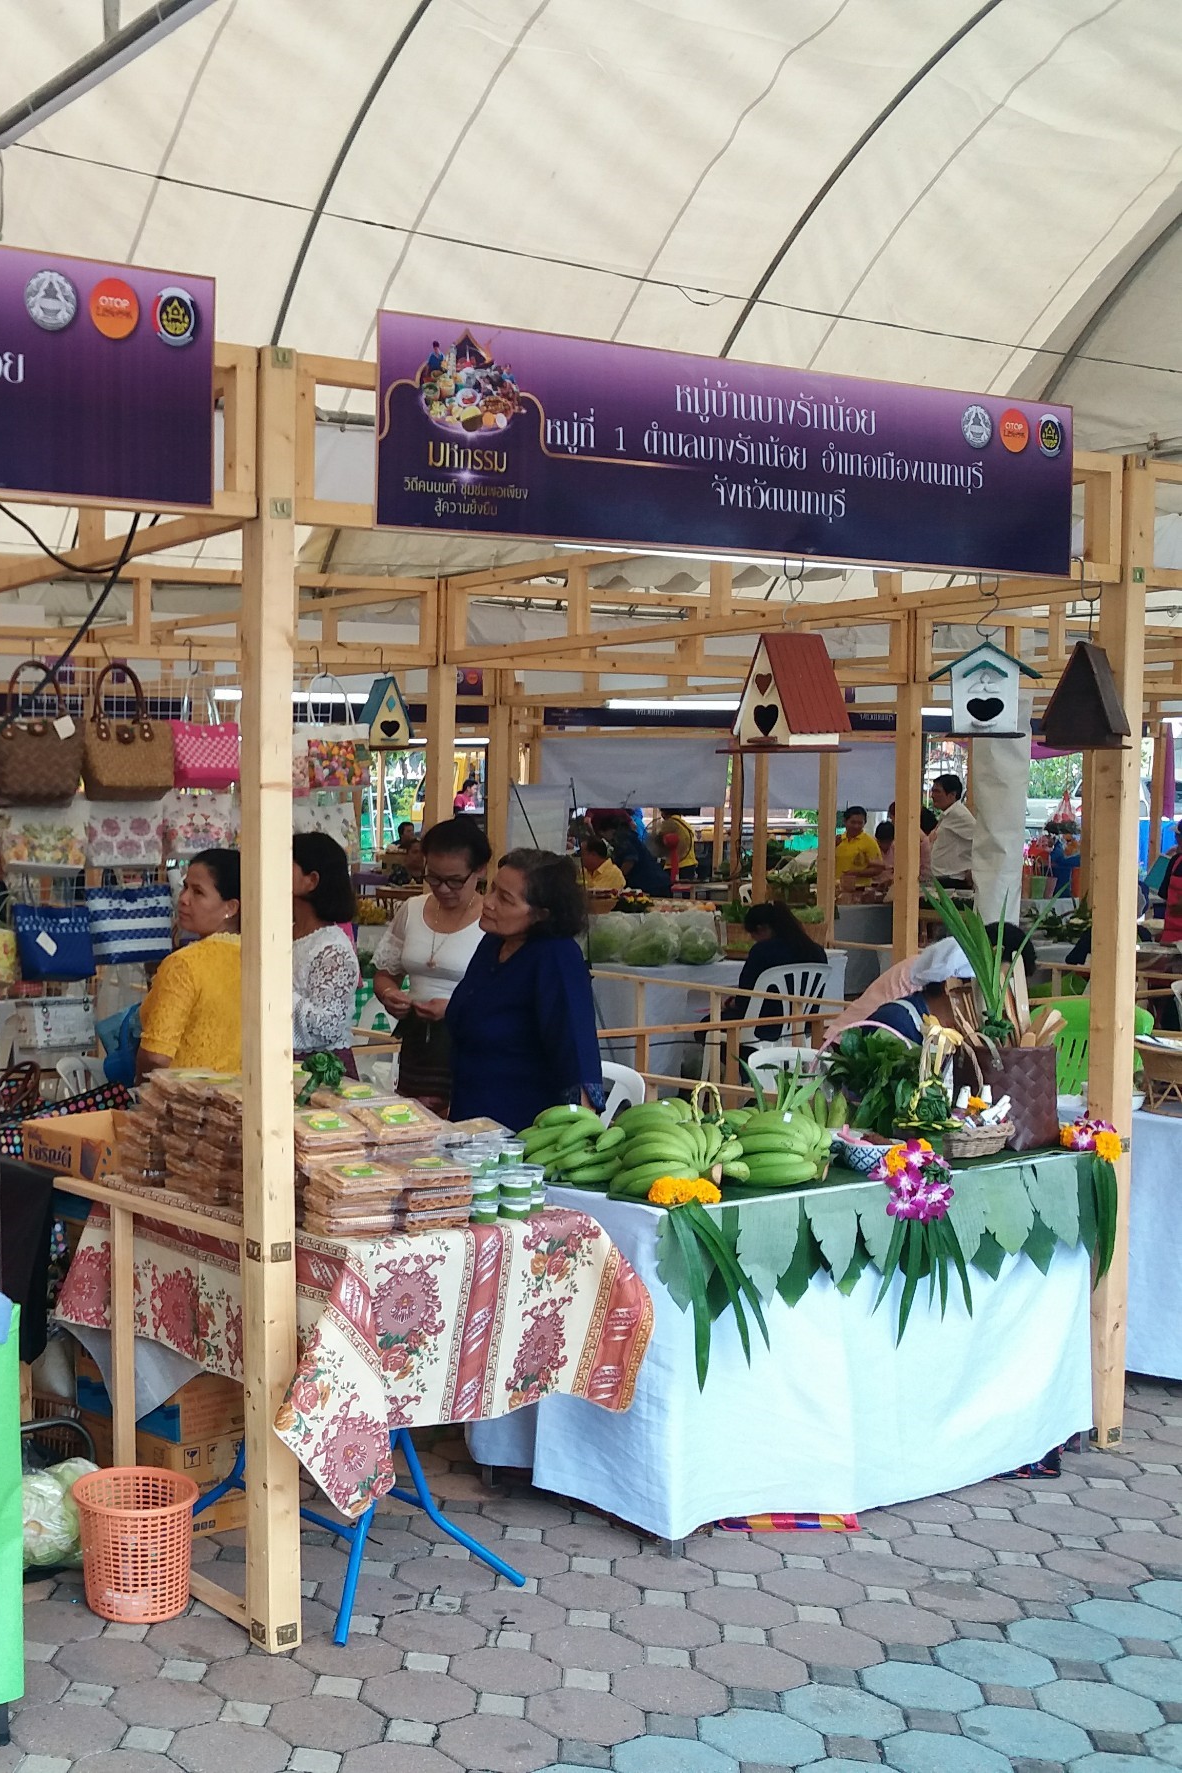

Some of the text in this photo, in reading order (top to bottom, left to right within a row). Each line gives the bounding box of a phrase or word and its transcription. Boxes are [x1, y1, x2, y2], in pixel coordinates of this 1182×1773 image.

[98, 295, 131, 309] OTOP
[675, 379, 878, 437] หมู่บ้านบางรักน้อย
[428, 441, 507, 473] มหกรรม
[546, 407, 984, 494] หมู่ที่ 1 ตำบลบางรักน้อย อำเภอเมืองนนทบุรี
[712, 474, 847, 522] จังหวัดนนทบุรี
